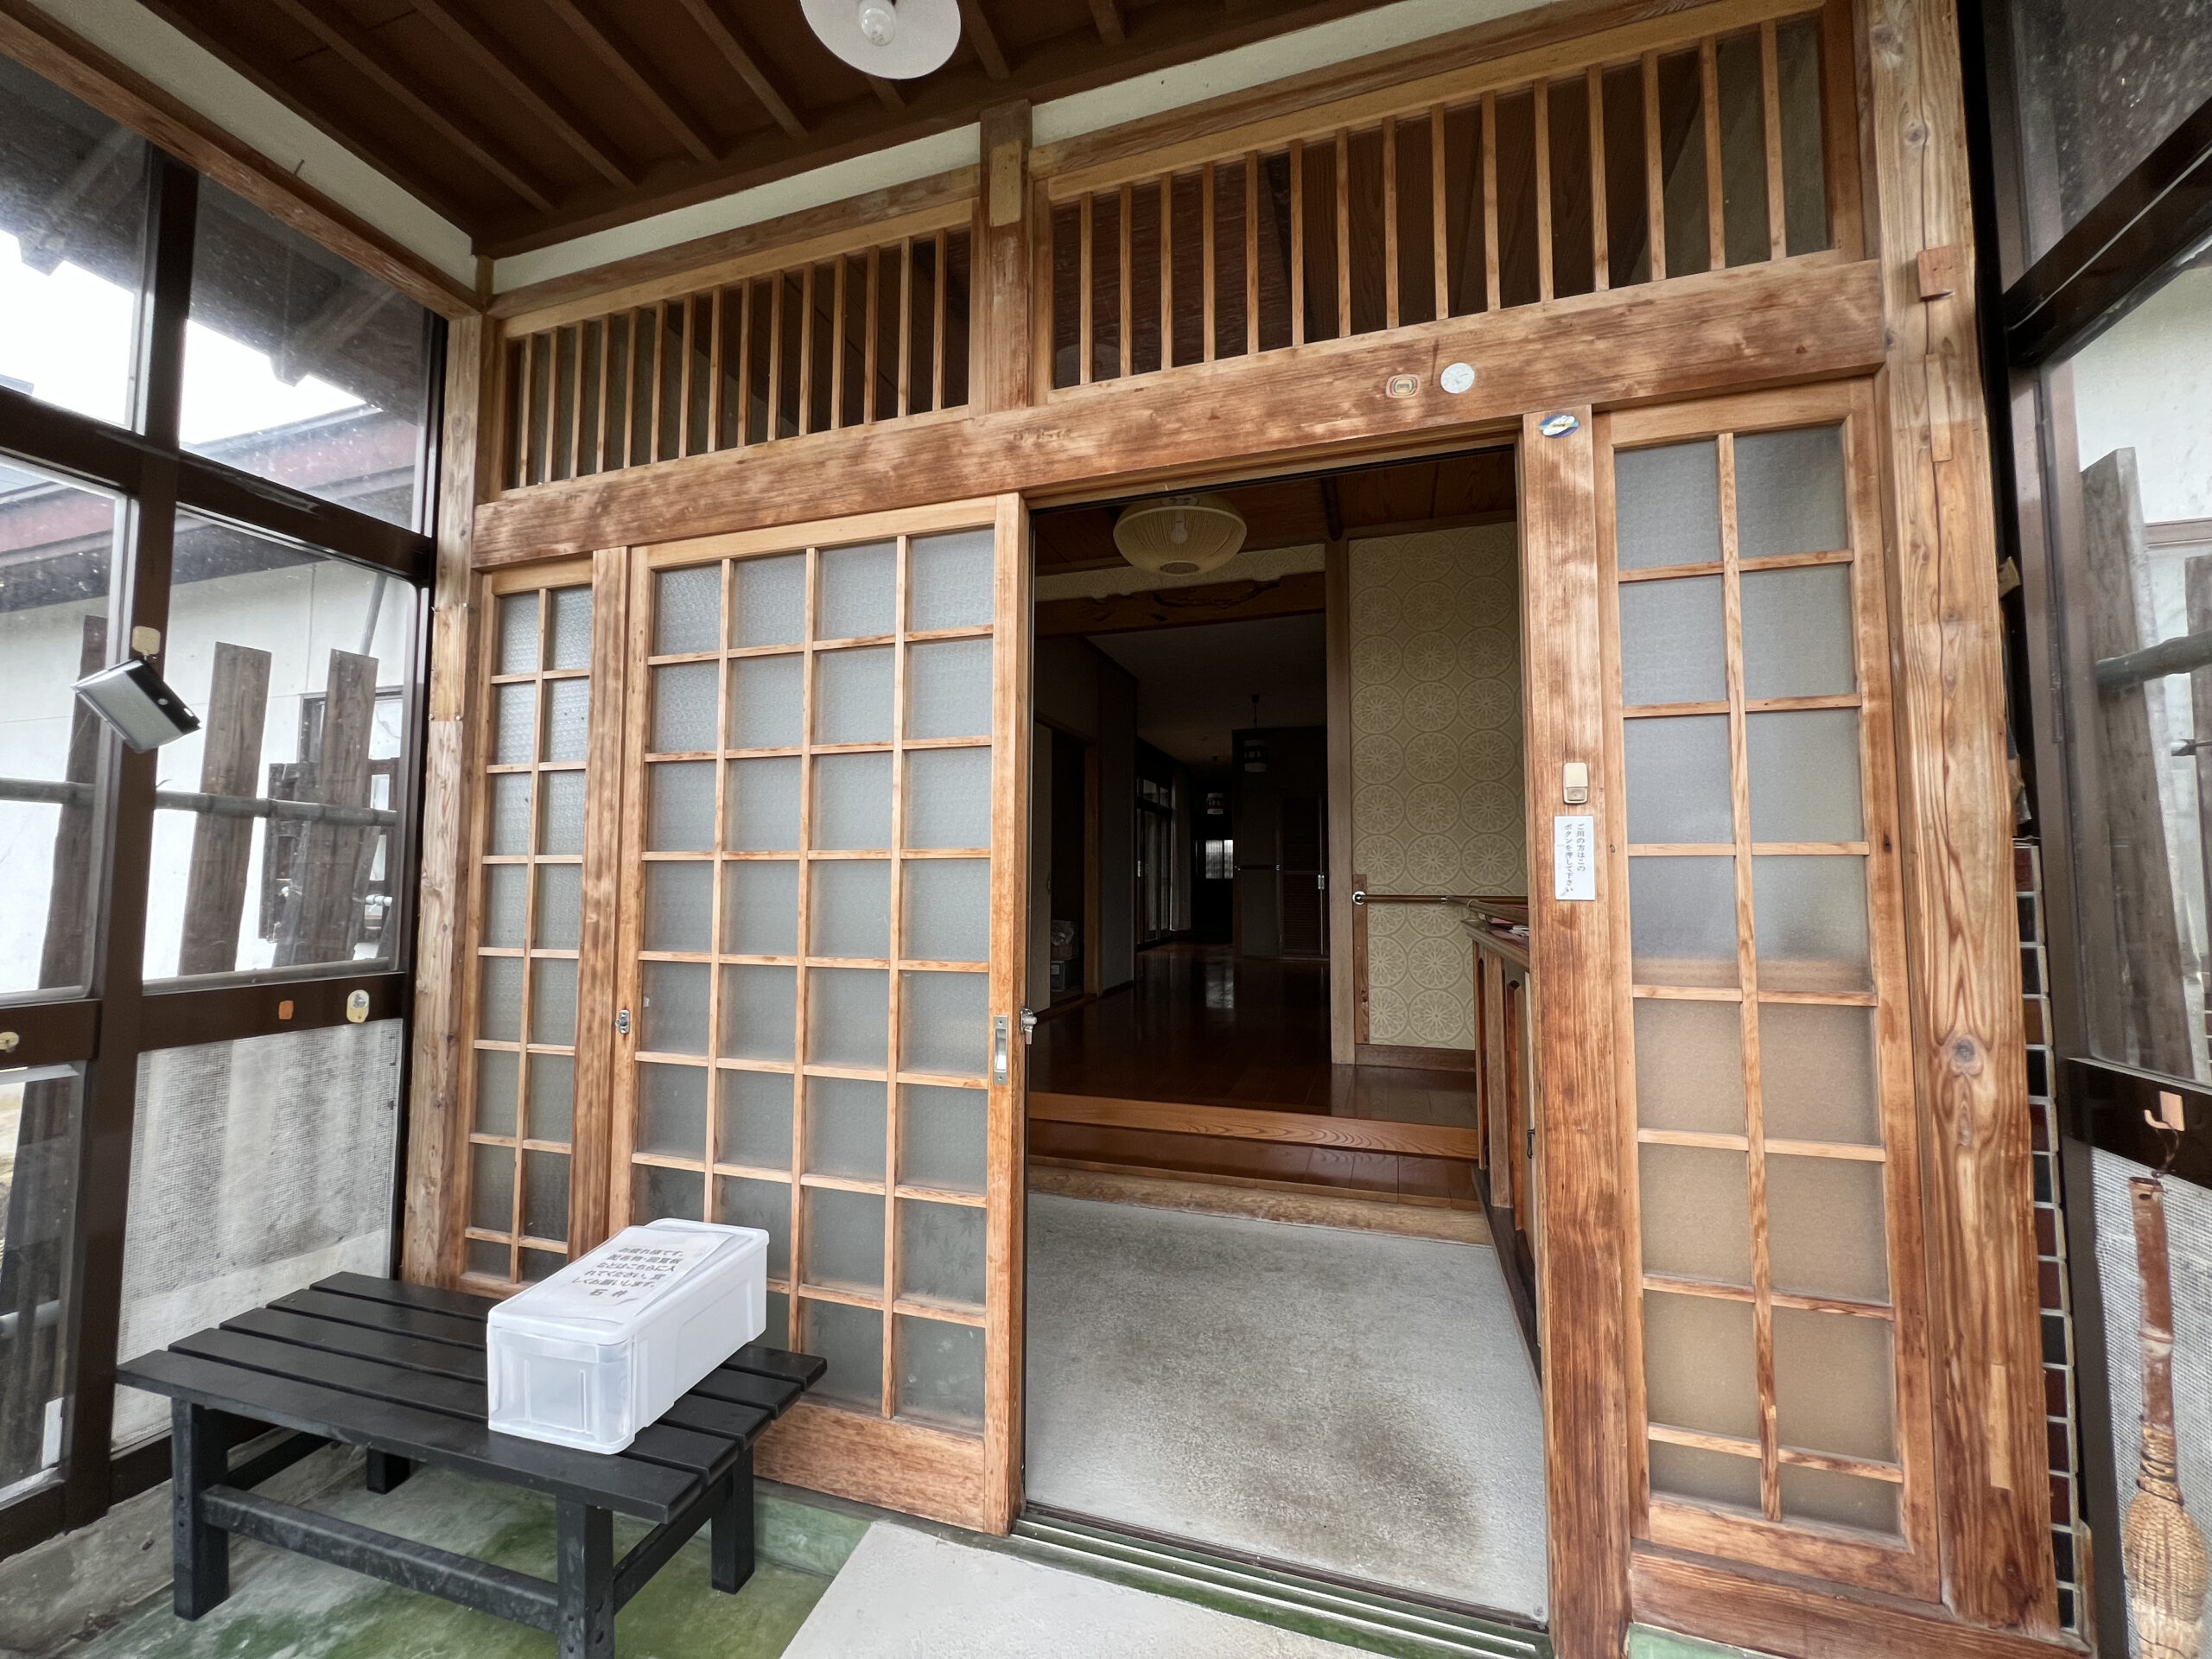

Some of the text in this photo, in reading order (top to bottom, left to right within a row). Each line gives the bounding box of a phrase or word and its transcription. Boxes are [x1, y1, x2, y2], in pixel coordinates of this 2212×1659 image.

[1565, 823, 1573, 892] ボタンを押して下さい
[1576, 823, 1586, 872] ご用の方はこの
